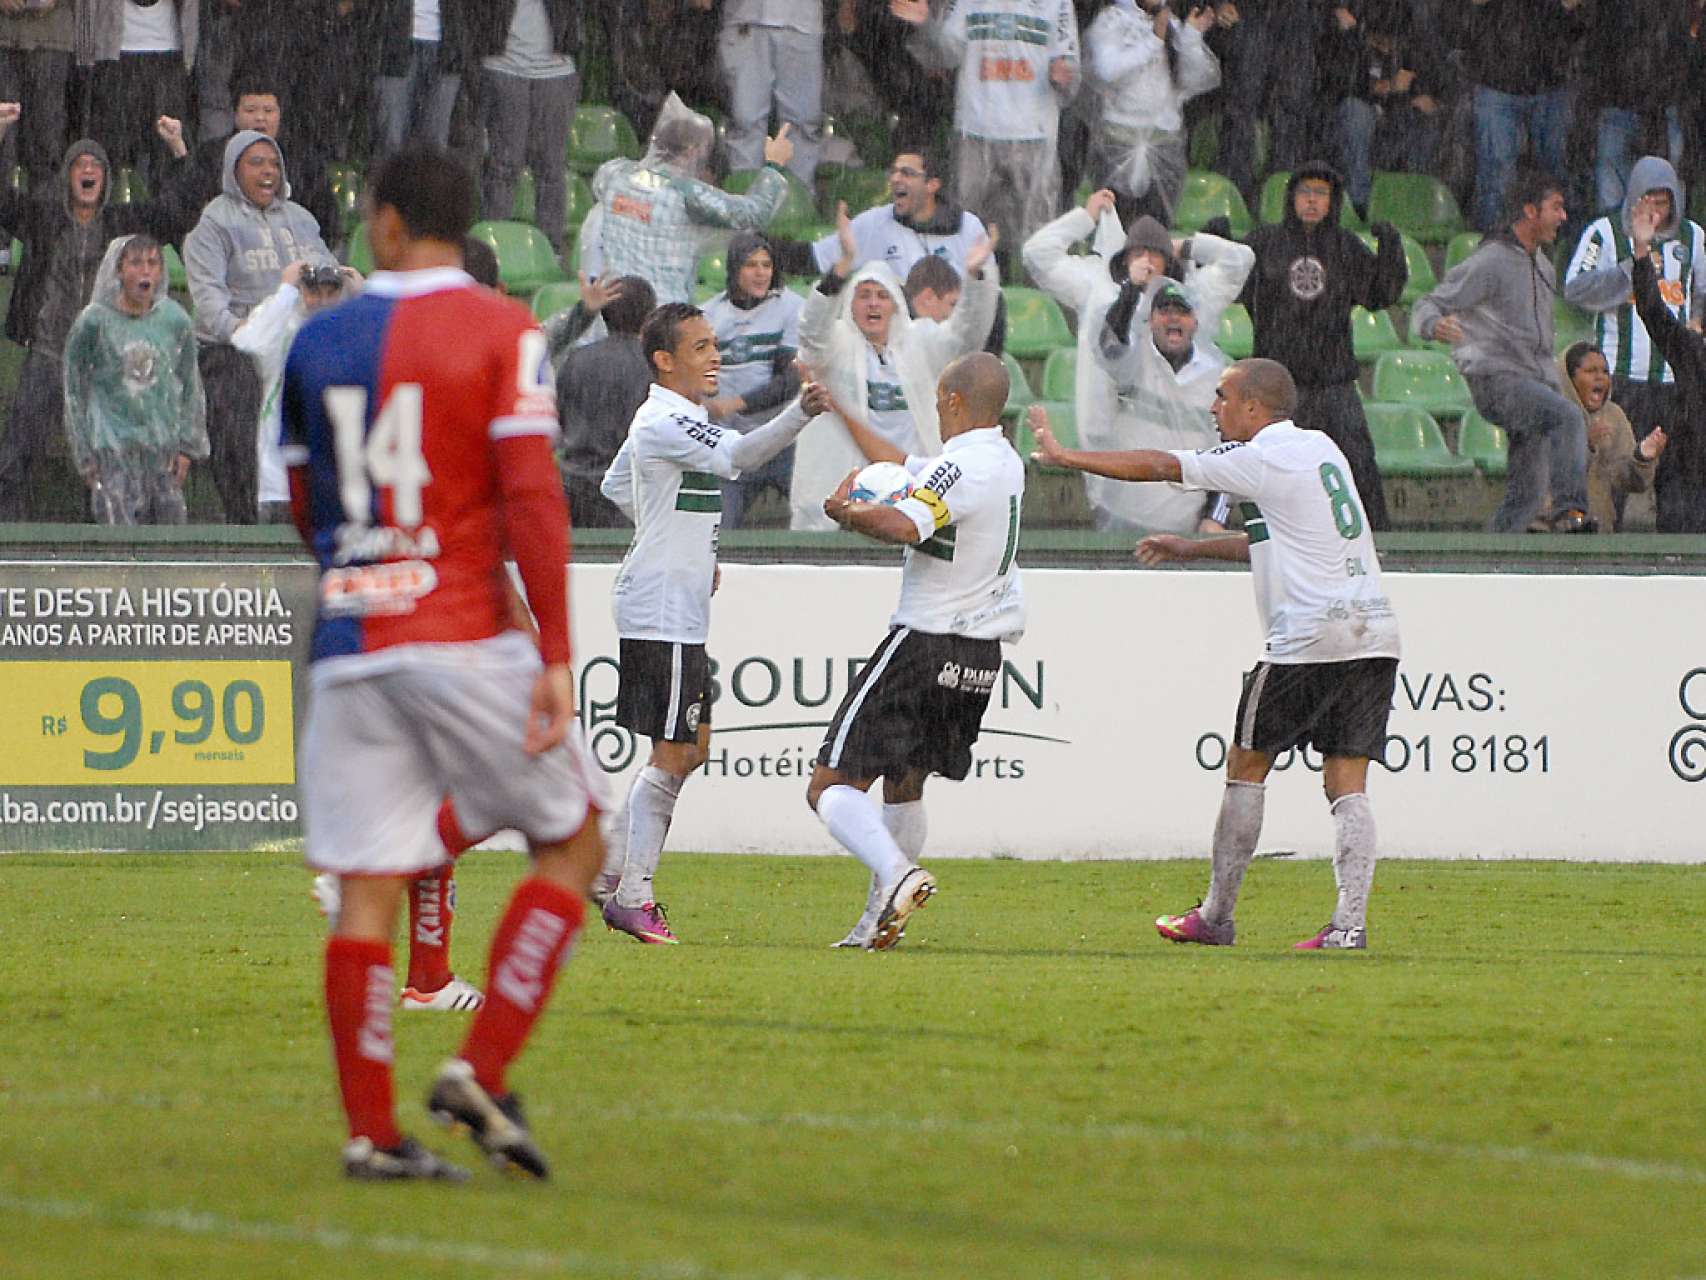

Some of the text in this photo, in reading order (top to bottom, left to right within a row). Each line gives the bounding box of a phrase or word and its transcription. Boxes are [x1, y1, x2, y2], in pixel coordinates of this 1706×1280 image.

[323, 382, 433, 527] 14
[1319, 462, 1363, 540] 8
[34, 587, 135, 618] DESTA
[142, 582, 292, 618] HISTÓRIA.
[1, 623, 293, 646] ANOS A PARTIR DE APENAS
[41, 676, 265, 770] R$ 9,90
[194, 749, 245, 761] mensais
[704, 746, 819, 777] Hotéis
[1451, 735, 1549, 773] 8181
